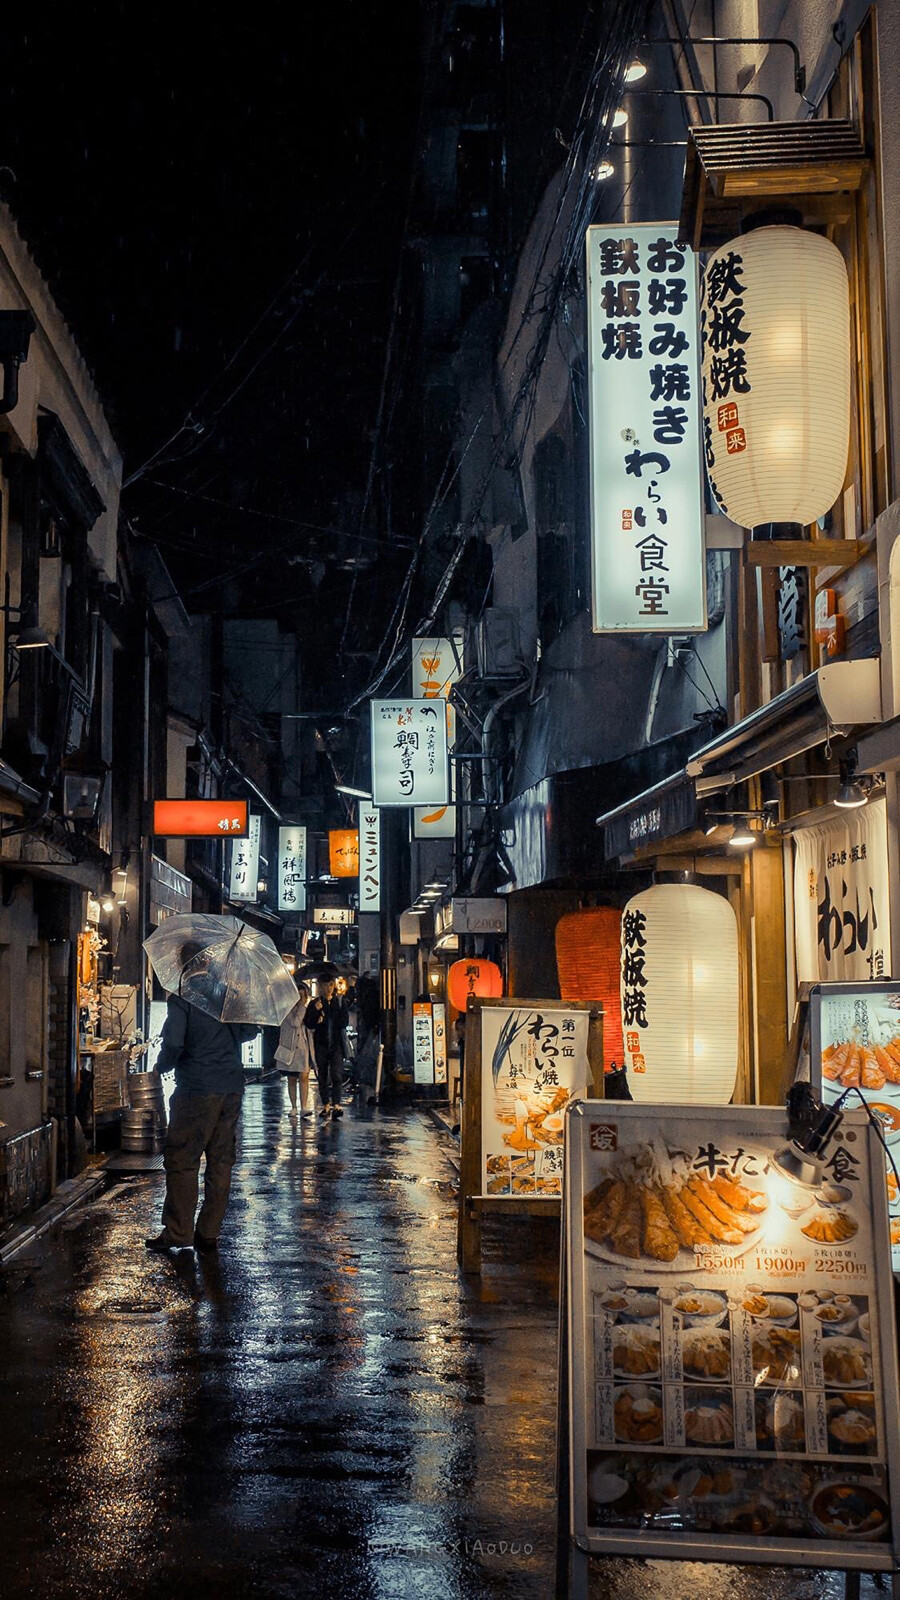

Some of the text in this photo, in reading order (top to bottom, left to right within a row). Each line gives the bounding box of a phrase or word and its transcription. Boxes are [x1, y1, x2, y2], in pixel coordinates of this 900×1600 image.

[600, 238, 643, 361] 鉄板焼
[707, 251, 752, 403] 鉄板焼
[647, 237, 691, 445] お好み焼き
[363, 832, 379, 900] ミュンヘン
[622, 909, 650, 1029] 鉄板焼
[561, 1018, 576, 1058] 第一位
[694, 1253, 745, 1270] 1550円
[755, 1256, 807, 1272] 1900円
[814, 1259, 867, 1275] 2250円
